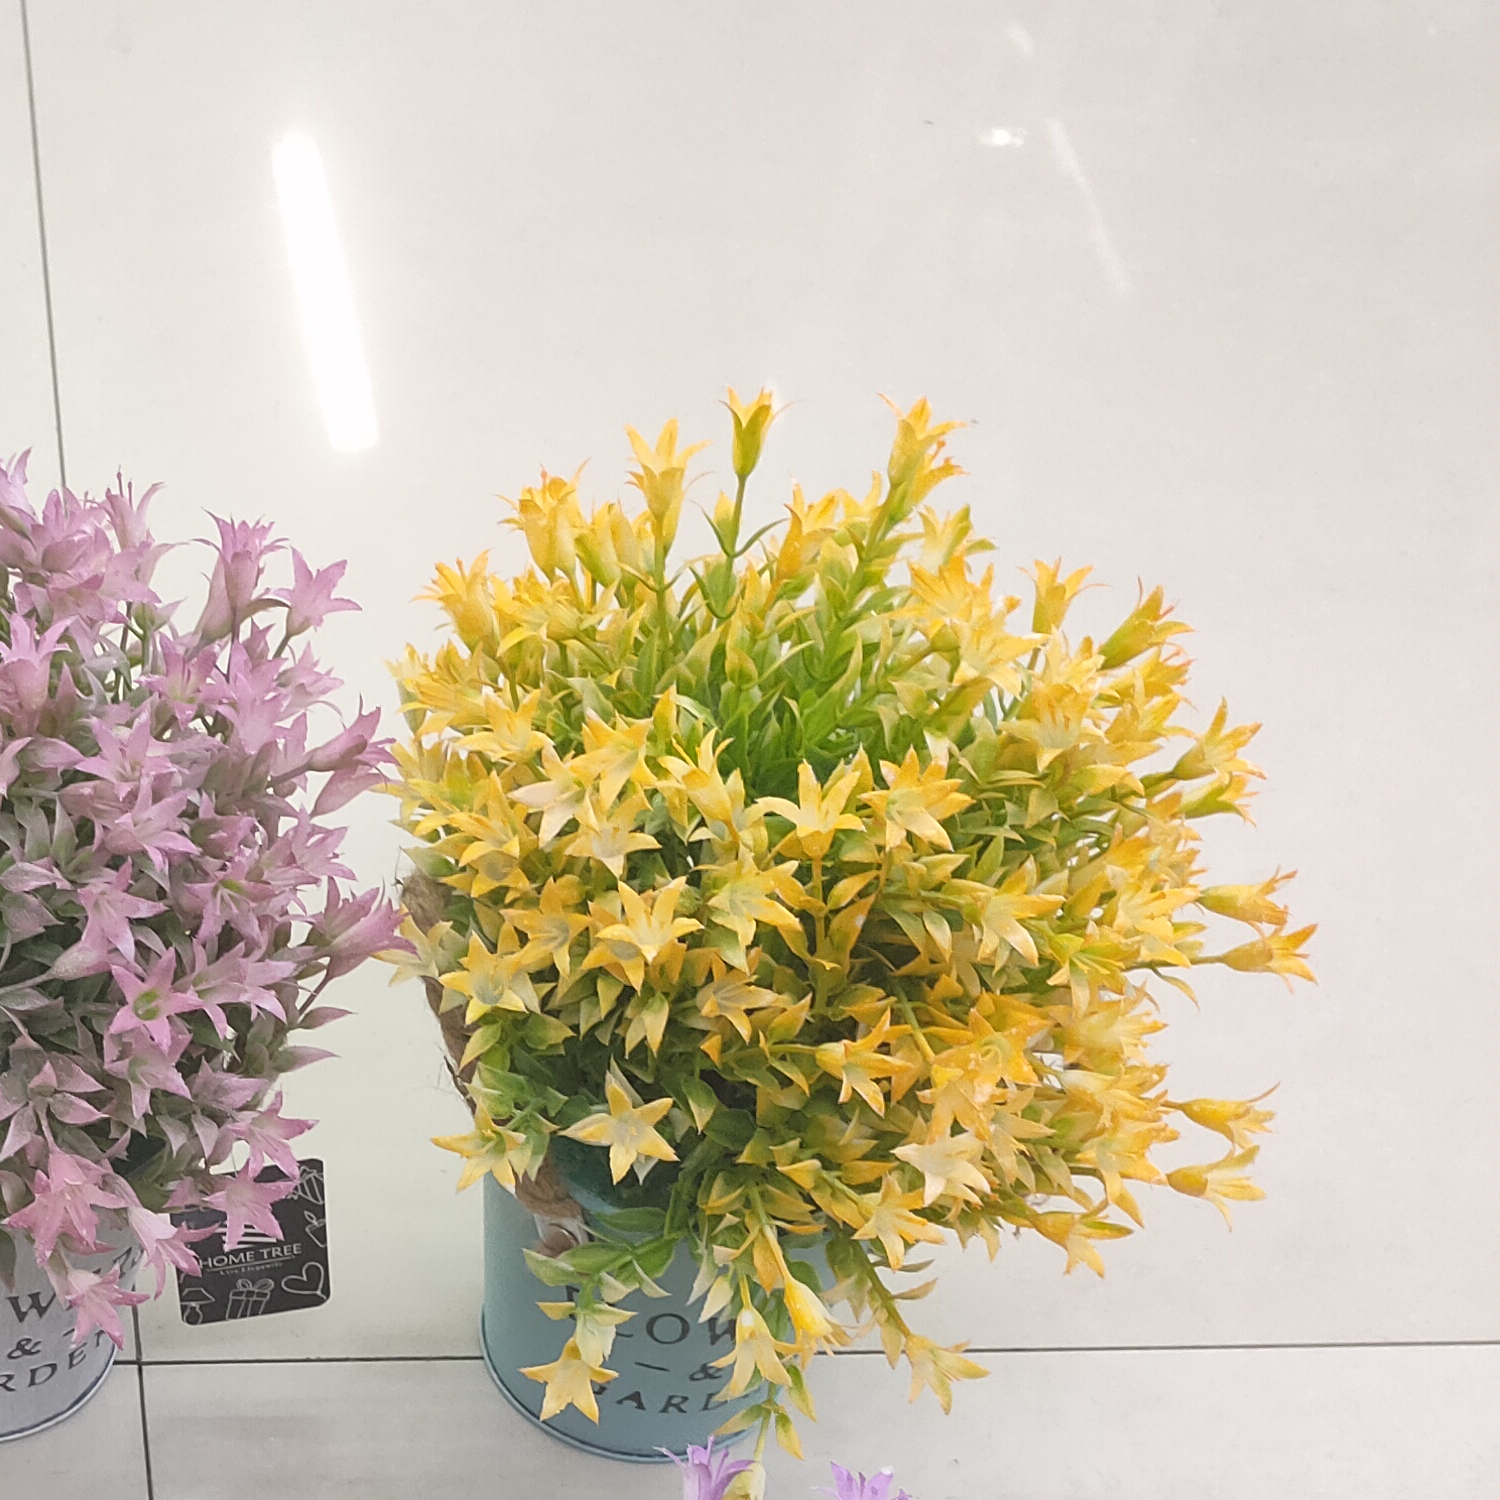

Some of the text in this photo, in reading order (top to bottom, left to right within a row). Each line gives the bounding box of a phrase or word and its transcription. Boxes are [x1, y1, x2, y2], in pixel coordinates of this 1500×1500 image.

[199, 1243, 302, 1268] HOME TREE
[7, 1337, 42, 1360] &
